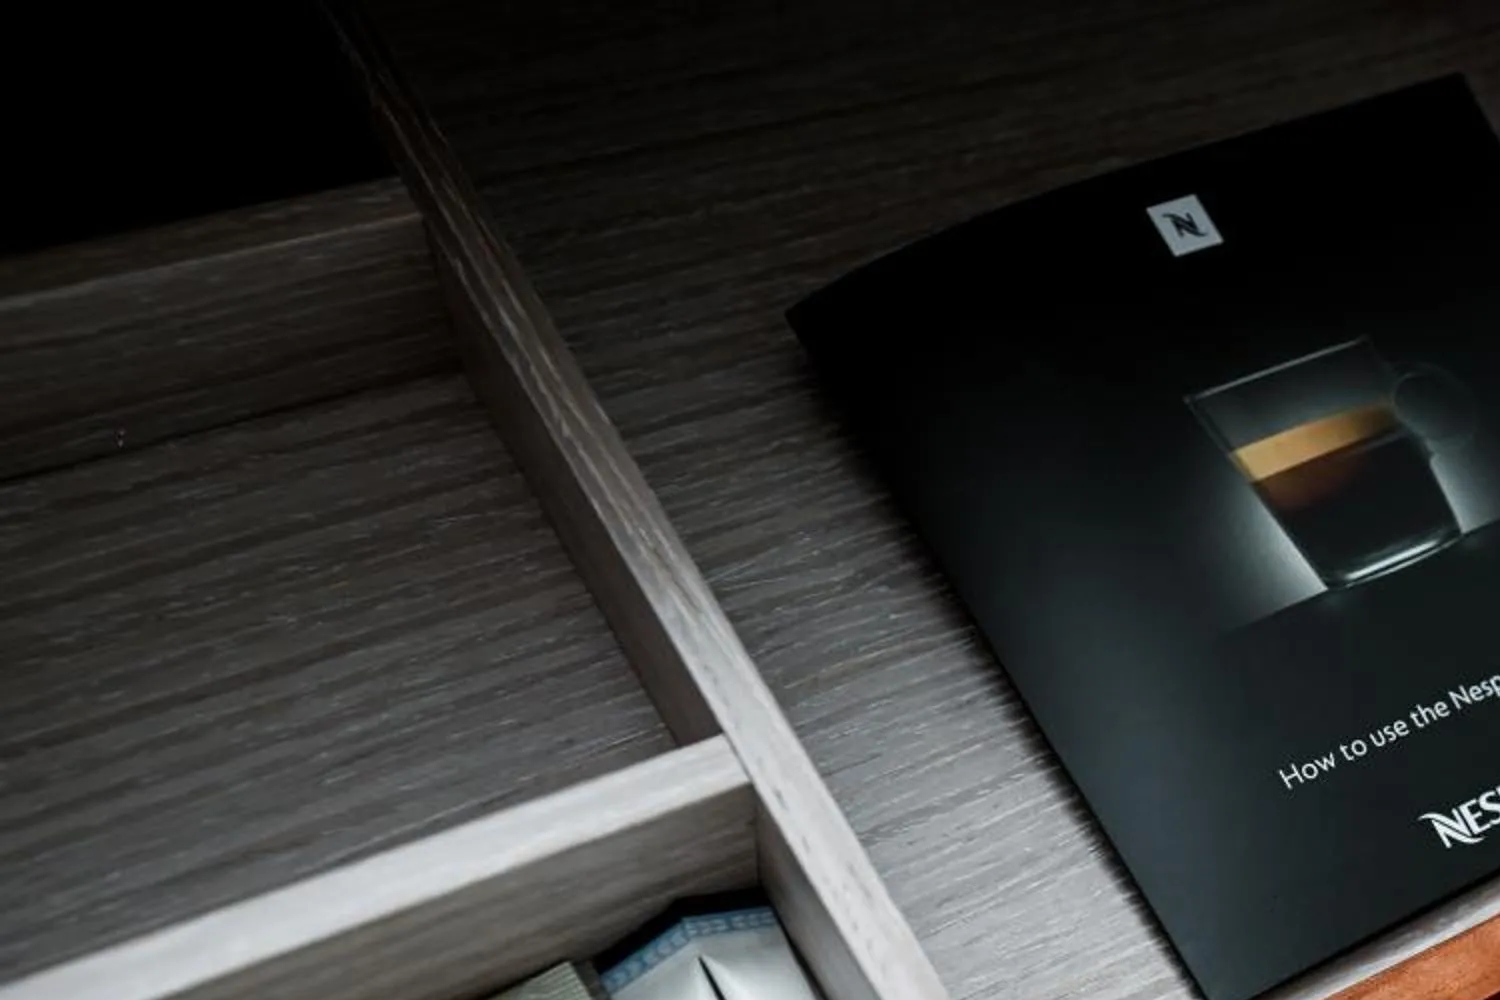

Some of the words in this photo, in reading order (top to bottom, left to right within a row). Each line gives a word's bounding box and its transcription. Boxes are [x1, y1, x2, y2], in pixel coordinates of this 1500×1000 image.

[1279, 753, 1336, 790] How
[1341, 736, 1368, 759] to
[1371, 718, 1409, 747] use
[1410, 694, 1450, 727] the
